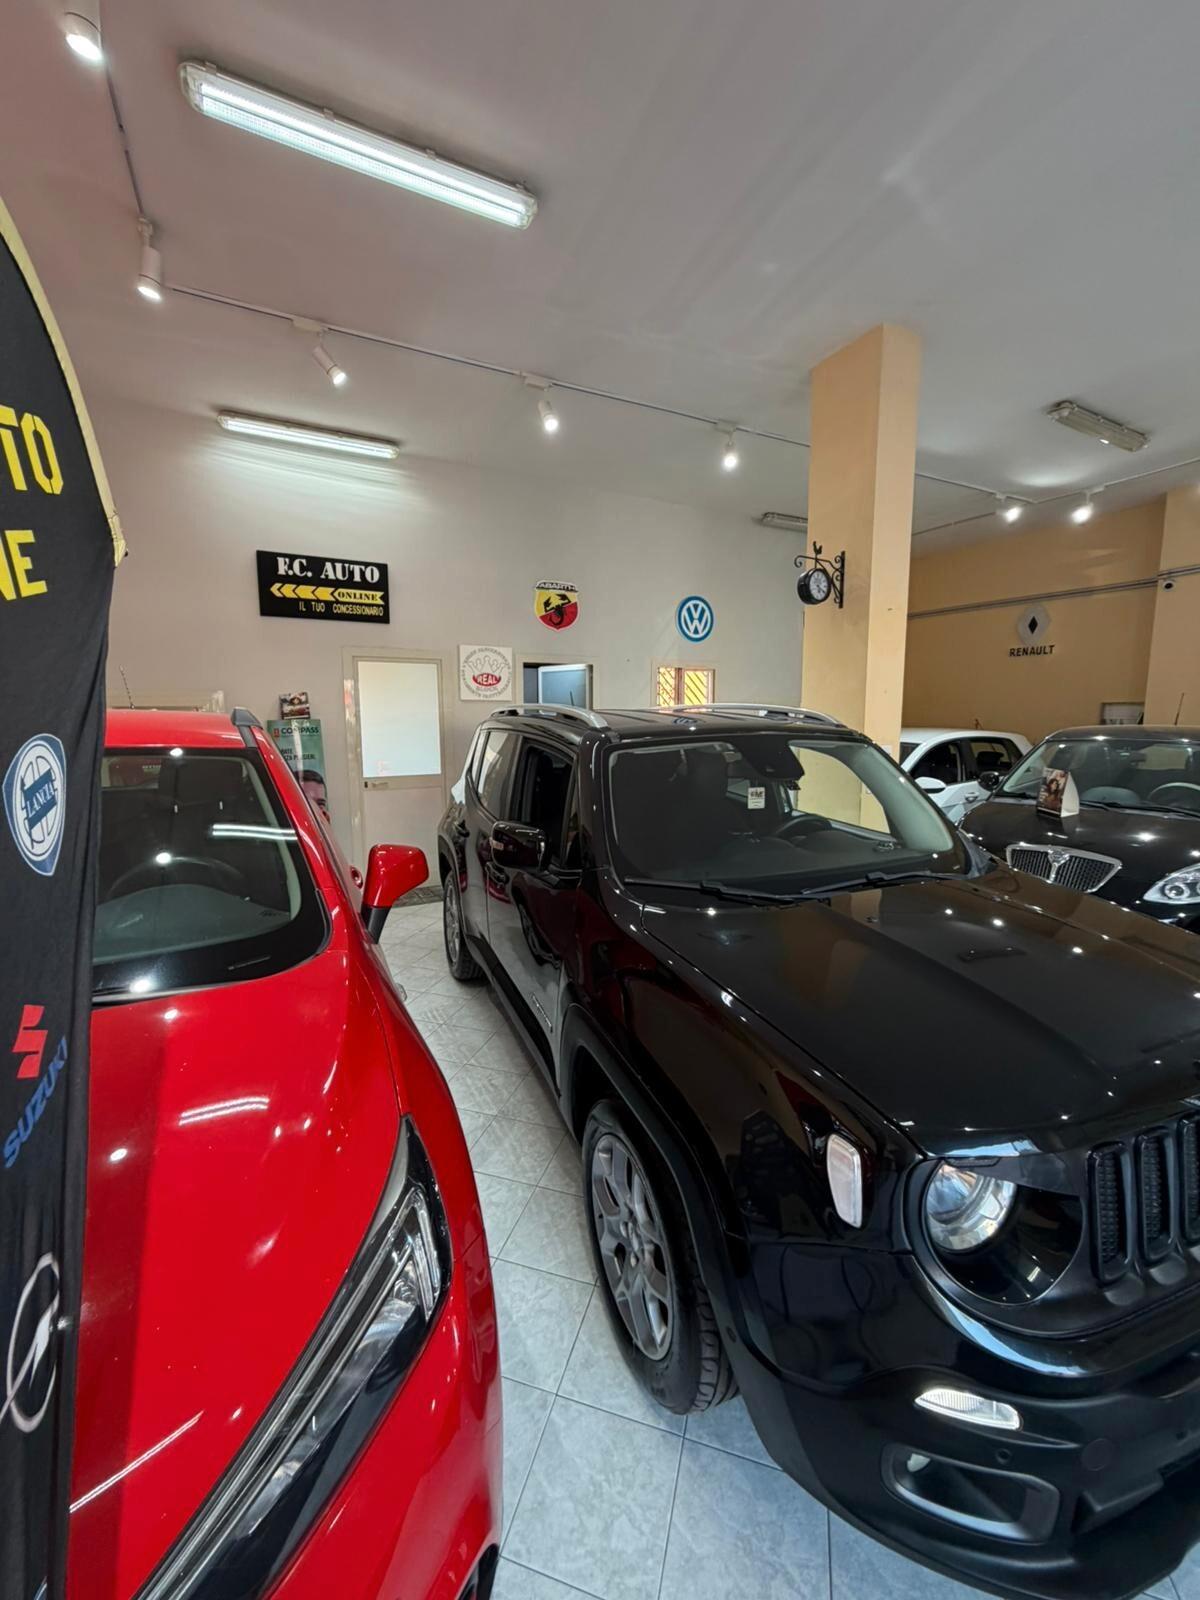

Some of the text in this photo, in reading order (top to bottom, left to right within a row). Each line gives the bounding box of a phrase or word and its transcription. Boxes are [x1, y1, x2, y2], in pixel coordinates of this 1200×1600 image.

[276, 556, 380, 584] F.C. AUTO
[538, 581, 578, 591] ABARTH
[337, 591, 378, 602] ONLINE
[299, 601, 384, 616] IL TUO CONCESSIONARIO
[1009, 644, 1056, 657] RENAULT
